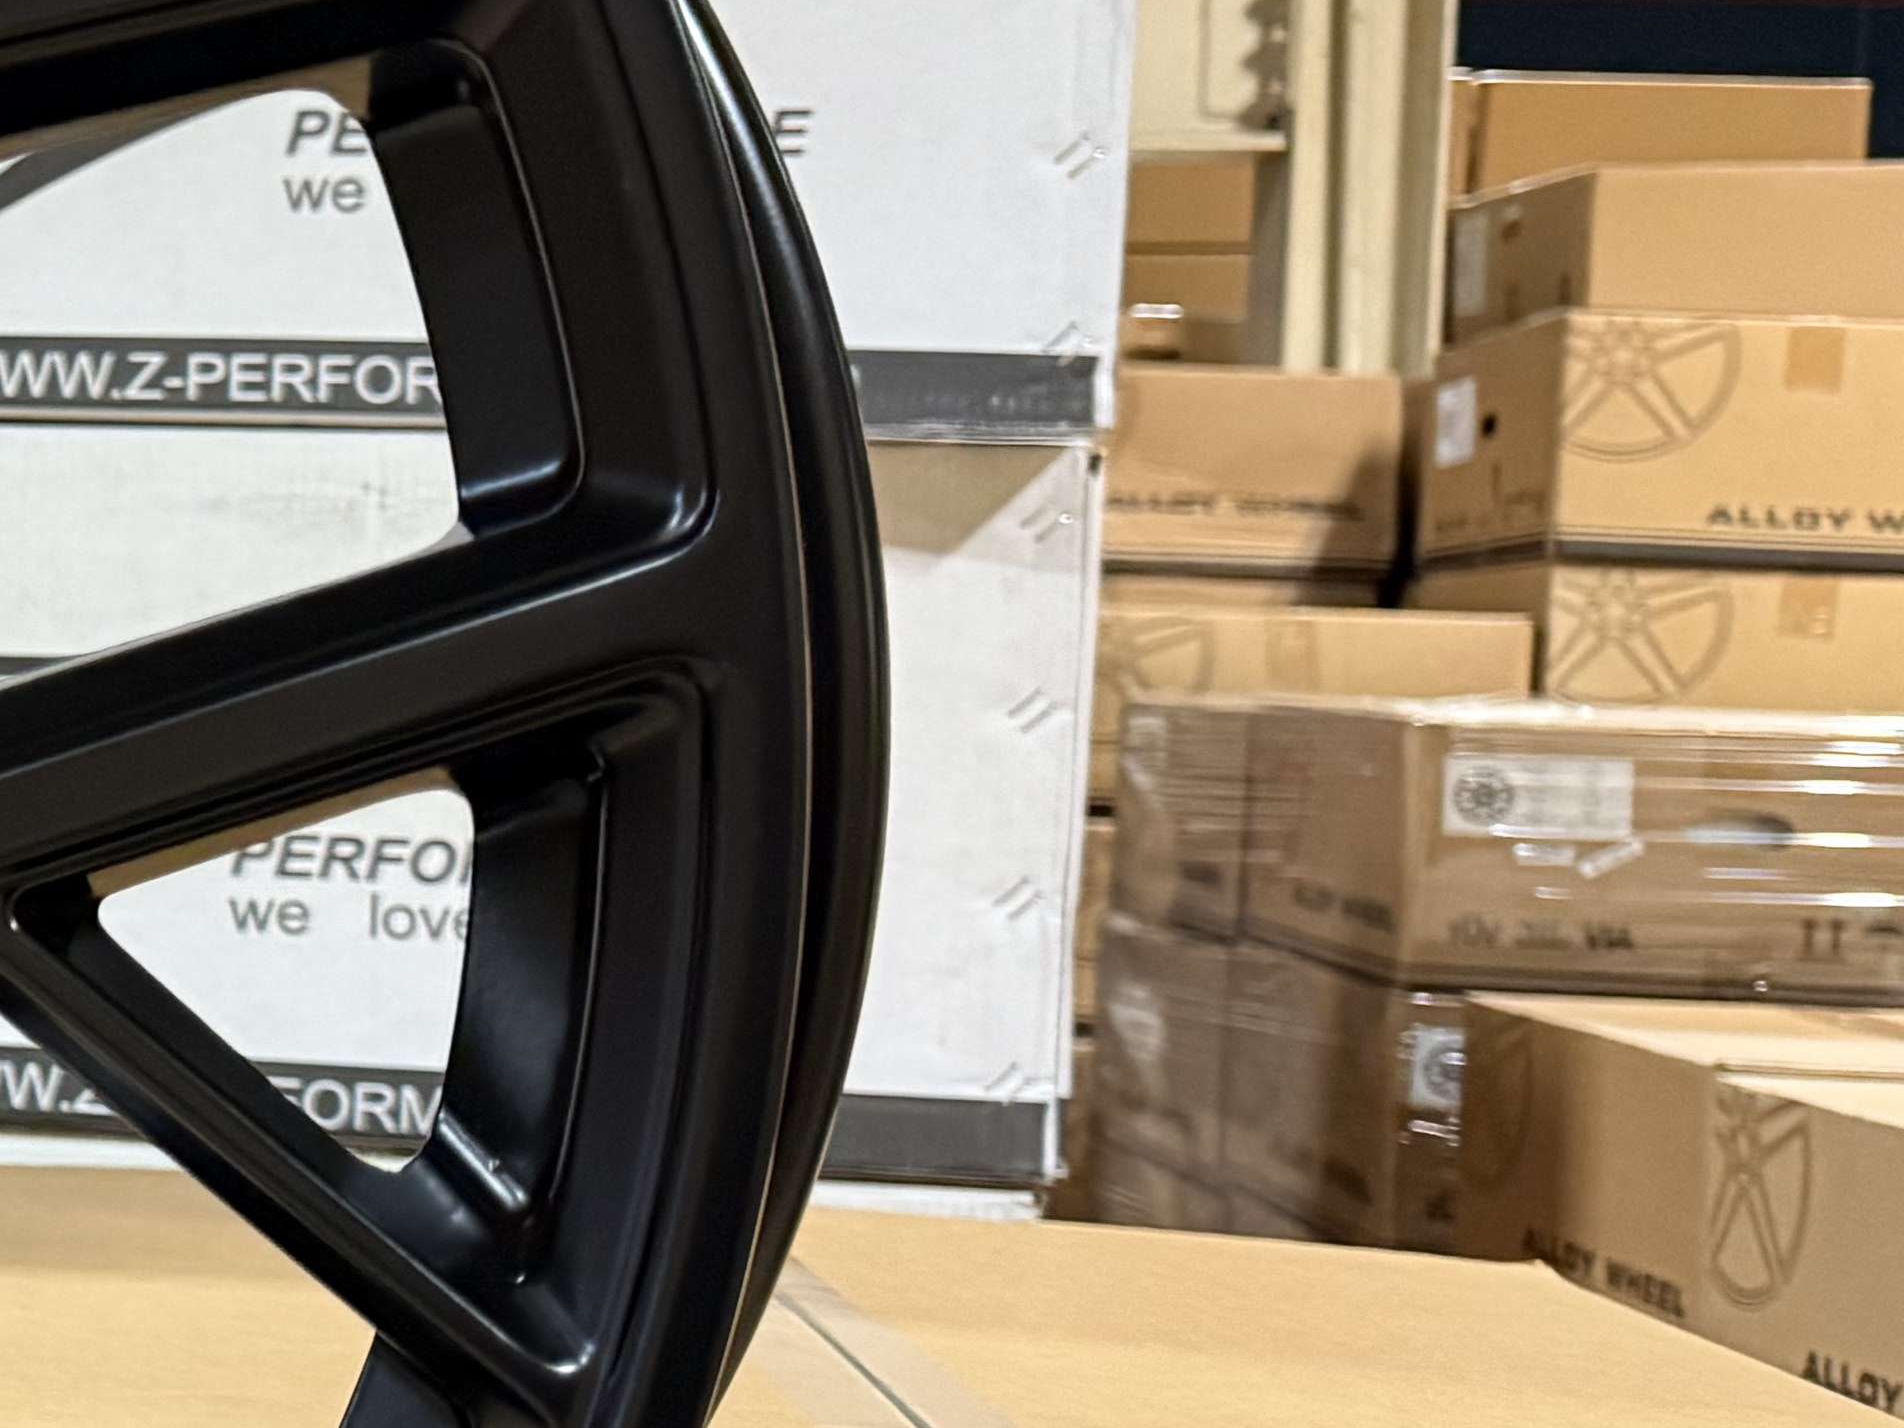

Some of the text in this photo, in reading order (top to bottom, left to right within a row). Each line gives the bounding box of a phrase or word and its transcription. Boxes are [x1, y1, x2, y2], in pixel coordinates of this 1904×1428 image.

[282, 175, 367, 213] we
[1704, 504, 1854, 532] ALLOY
[229, 834, 473, 885] PERFO
[228, 898, 311, 936] we
